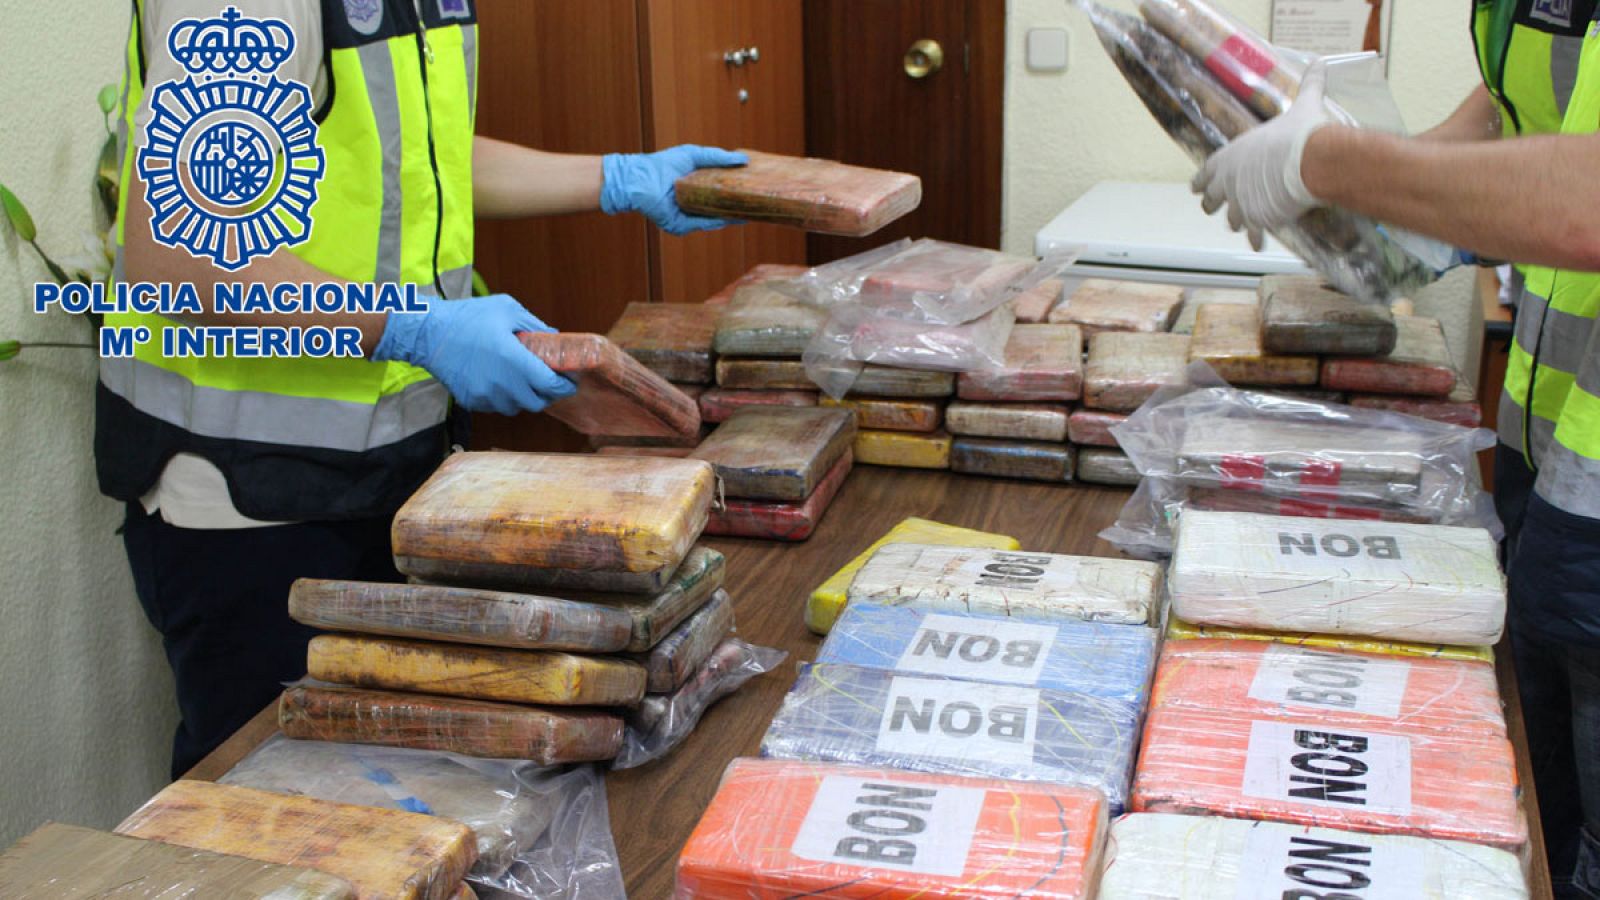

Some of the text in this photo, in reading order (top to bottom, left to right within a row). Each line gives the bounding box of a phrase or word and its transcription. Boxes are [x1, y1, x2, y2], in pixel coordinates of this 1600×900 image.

[1279, 531, 1400, 559] BON
[912, 629, 1043, 667] BON
[889, 696, 1027, 743] BON
[1287, 729, 1369, 805] BON
[834, 783, 938, 866] BON
